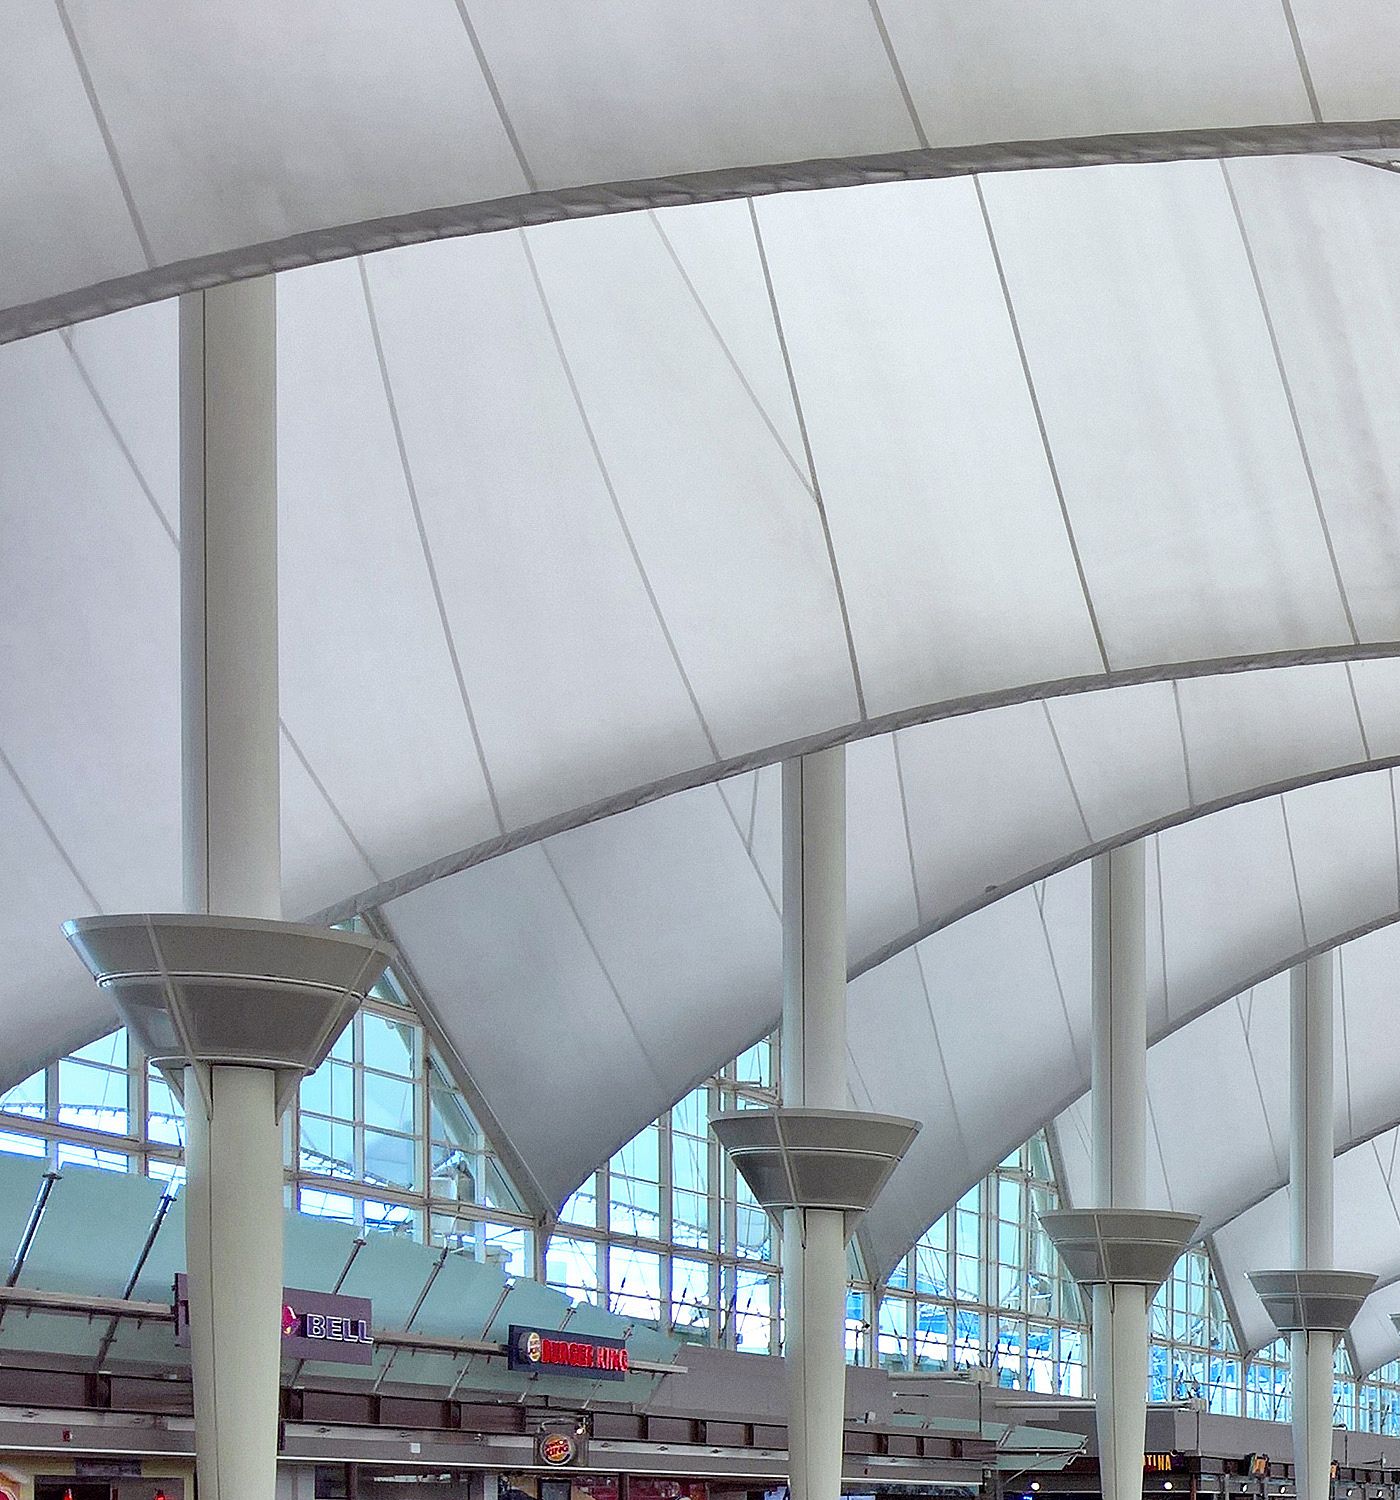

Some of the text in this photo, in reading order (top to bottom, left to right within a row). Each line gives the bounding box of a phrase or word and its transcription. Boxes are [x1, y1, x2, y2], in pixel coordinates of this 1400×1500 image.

[307, 1313, 374, 1344] BELL
[541, 1339, 593, 1368] BURGER
[597, 1345, 628, 1373] KING
[1143, 1454, 1172, 1471] TINA
